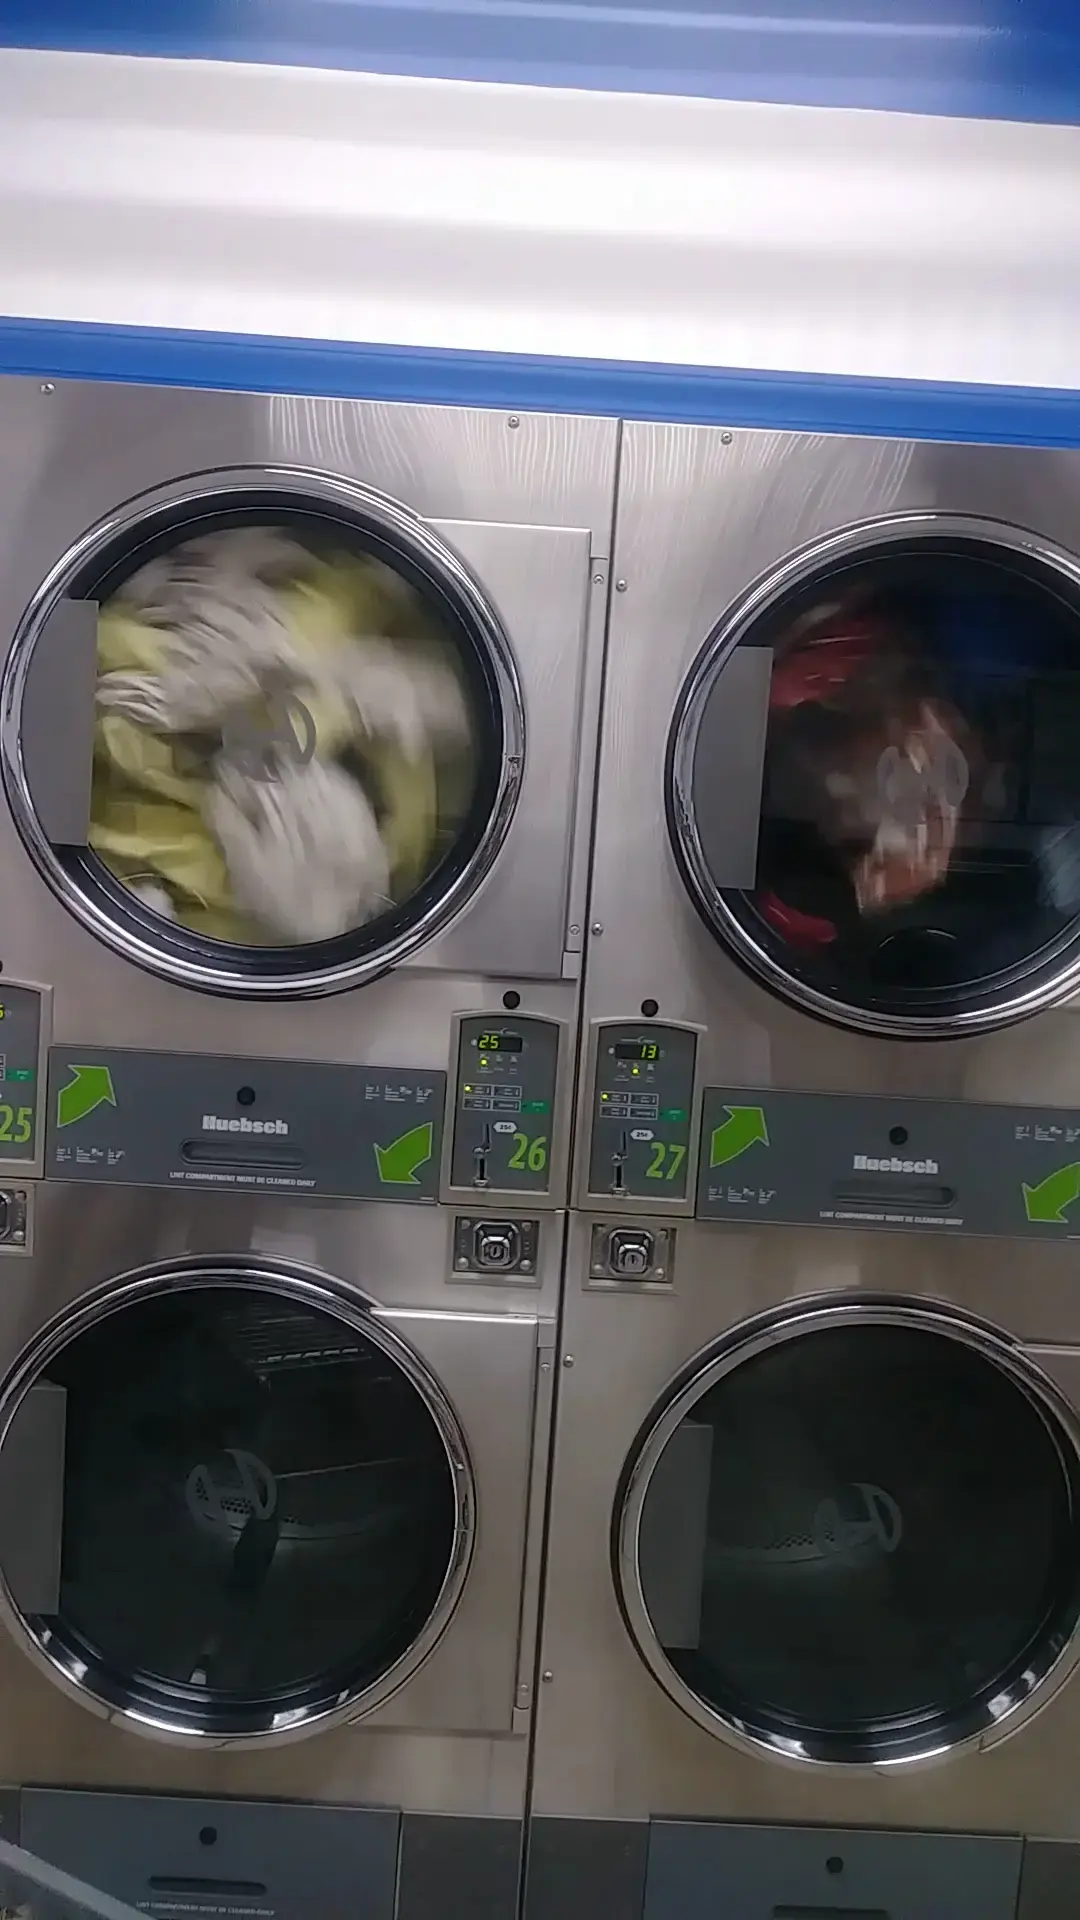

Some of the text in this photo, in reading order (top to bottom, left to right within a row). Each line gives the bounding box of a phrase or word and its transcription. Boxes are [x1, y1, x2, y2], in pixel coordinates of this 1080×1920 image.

[479, 1034, 499, 1049] 25
[641, 1045, 656, 1059] 13
[0, 1105, 32, 1143] 25
[202, 1114, 288, 1135] Huebsch
[508, 1133, 547, 1171] 26
[646, 1142, 686, 1180] 27
[853, 1154, 938, 1174] Huebsch
[236, 1175, 256, 1183] MUST
